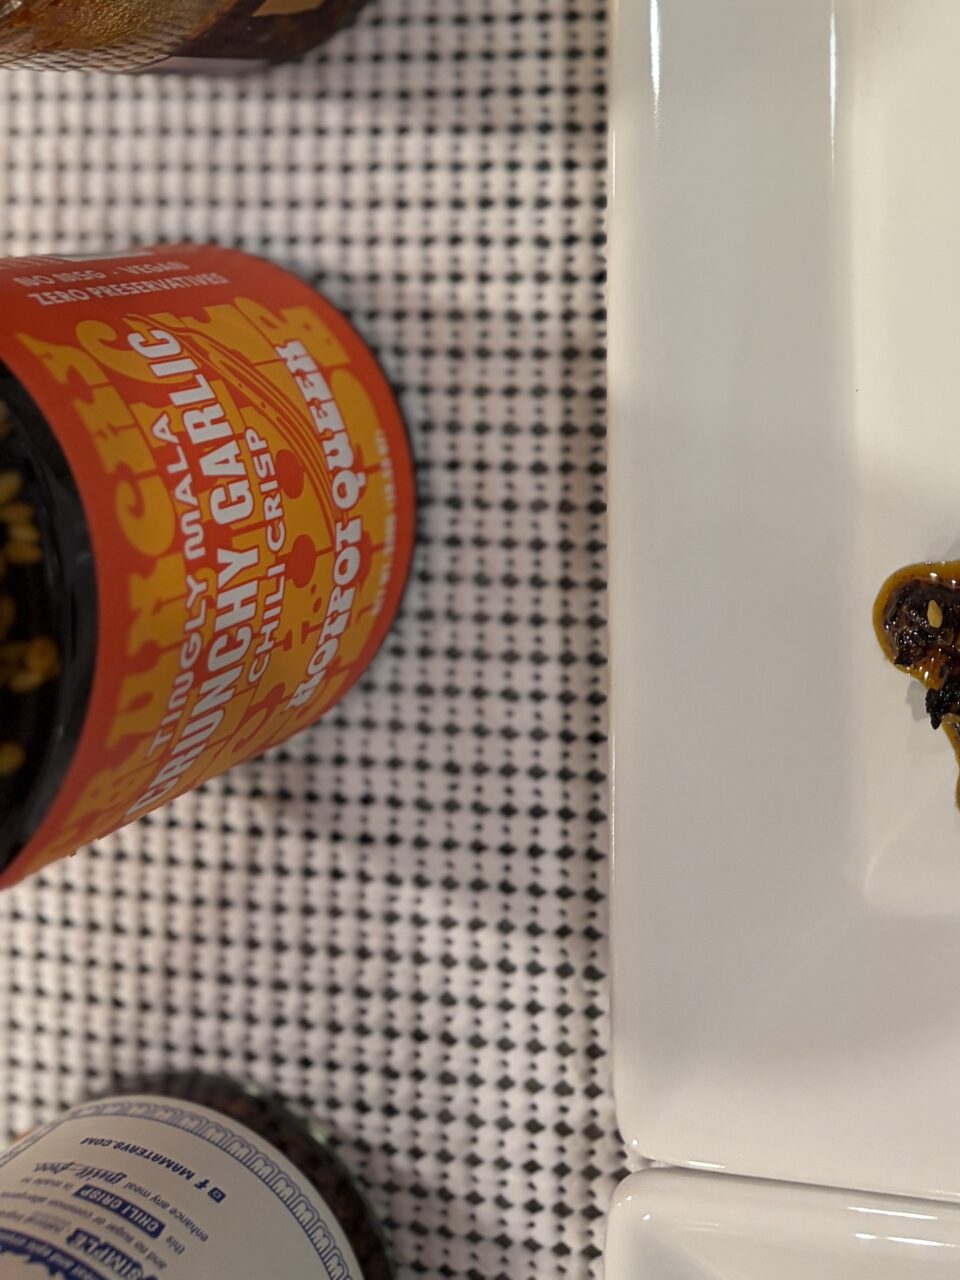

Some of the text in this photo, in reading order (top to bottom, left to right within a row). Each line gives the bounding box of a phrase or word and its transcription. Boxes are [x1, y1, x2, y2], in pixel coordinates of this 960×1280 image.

[14, 275, 55, 287] NO
[27, 272, 230, 306] ZERO PRESERVATIVES
[126, 328, 260, 816] CRUNCHY GARLIC
[147, 412, 208, 757] TINGLY MALA
[244, 425, 287, 684] CHILI CRISP
[275, 338, 367, 711] HOTPOT QUEEN
[80, 1187, 123, 1210] CRISP
[121, 1204, 160, 1232] CHILI
